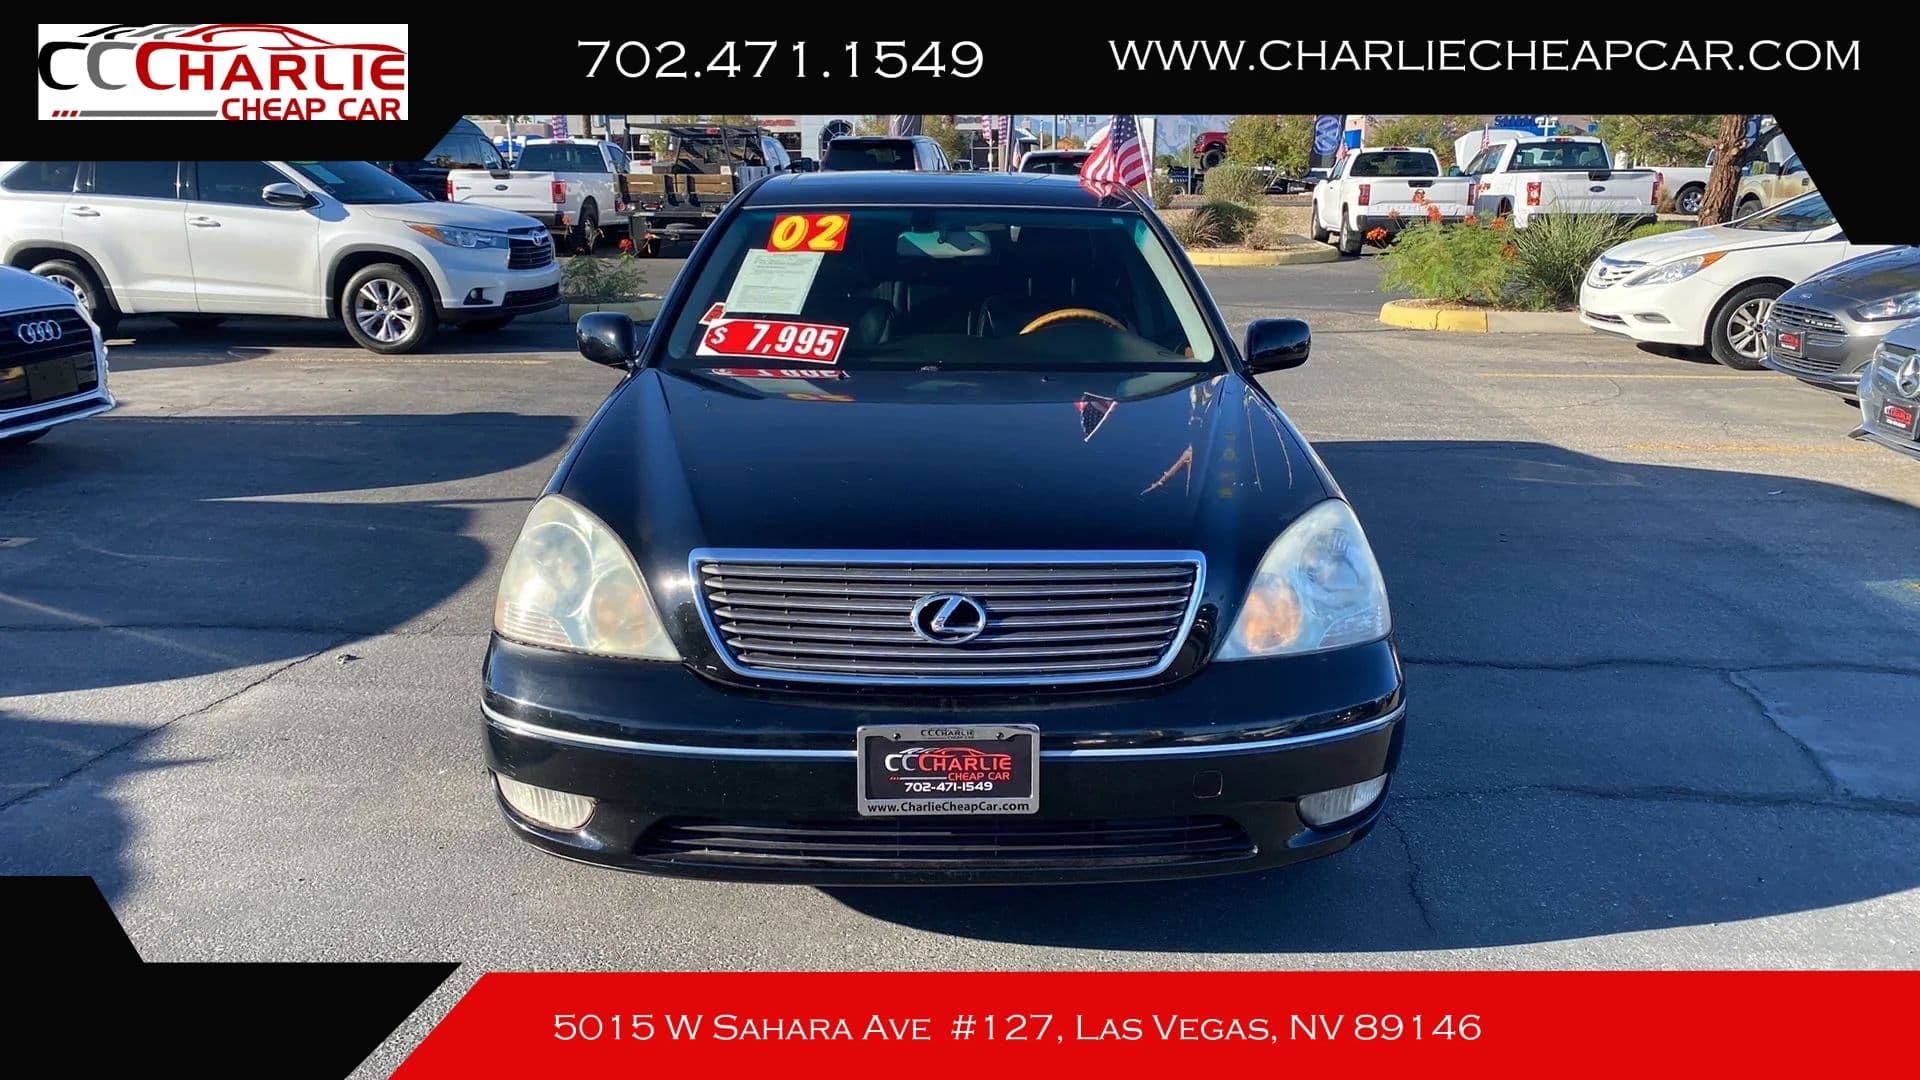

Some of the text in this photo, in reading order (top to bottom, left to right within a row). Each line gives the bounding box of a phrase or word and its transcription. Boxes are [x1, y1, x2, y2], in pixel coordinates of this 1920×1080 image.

[771, 214, 847, 250] 02
[745, 323, 839, 357] 7,995
[947, 771, 1011, 782] CHEAP CAR
[904, 781, 994, 793] 702-471-1549
[867, 801, 1030, 814] www.CharlieCheapCar.com
